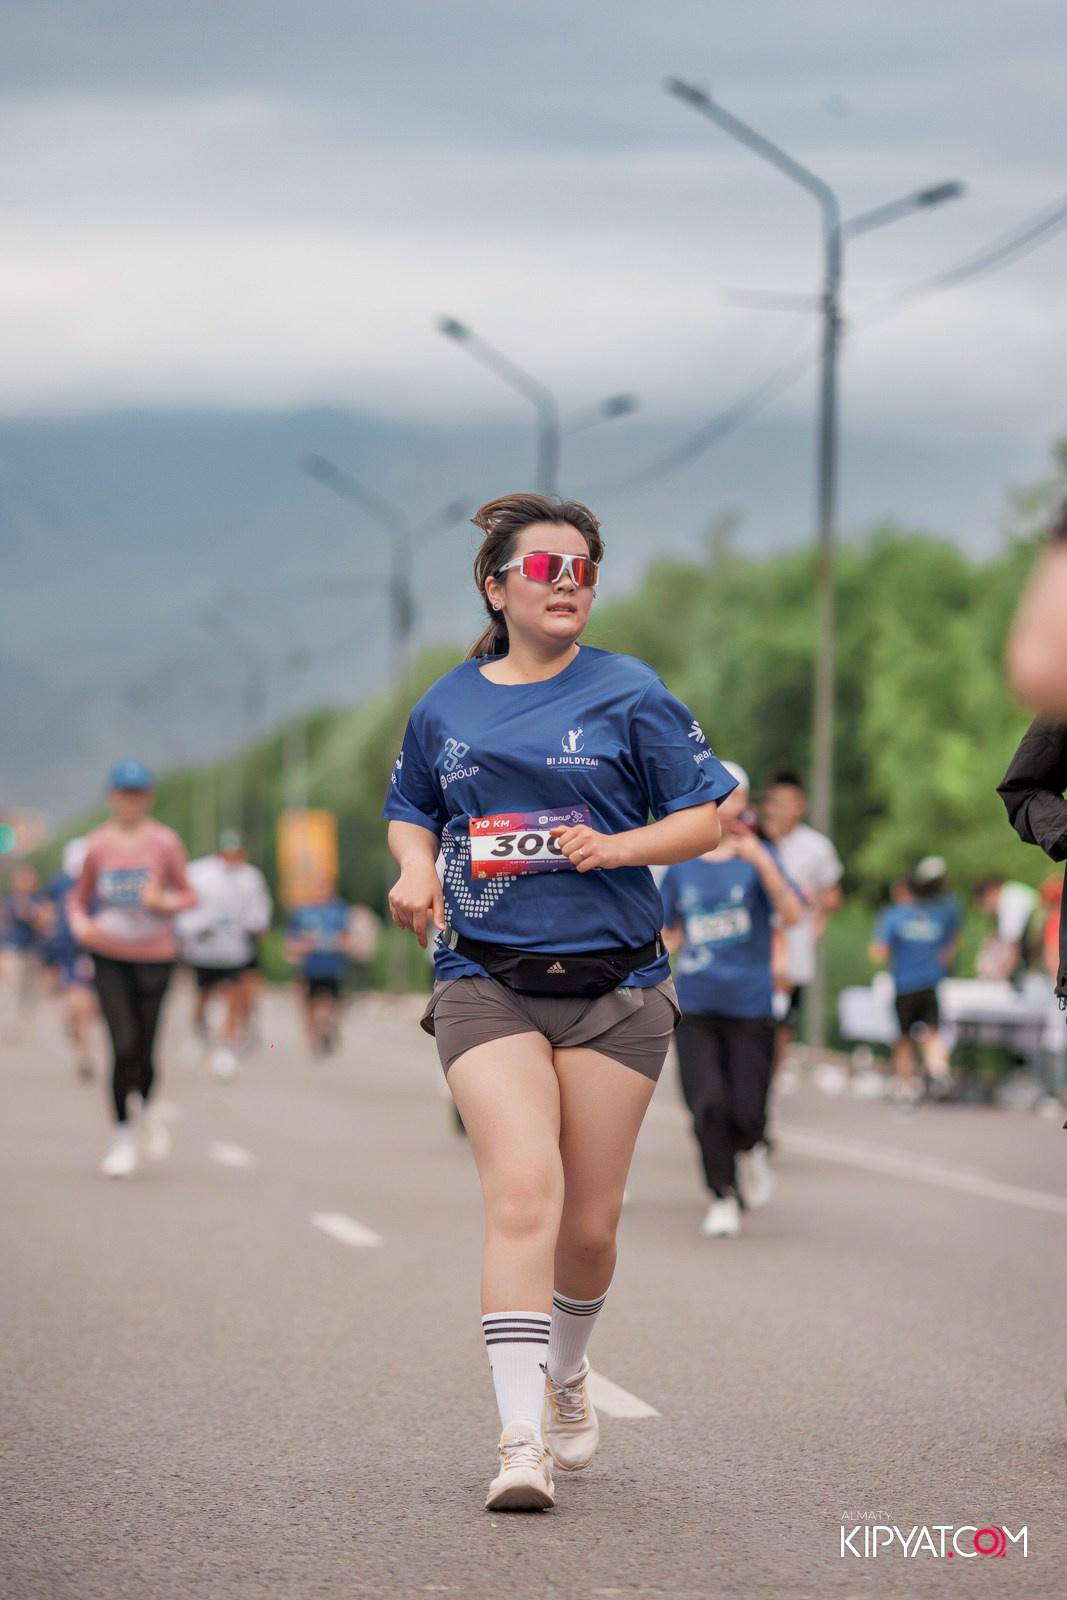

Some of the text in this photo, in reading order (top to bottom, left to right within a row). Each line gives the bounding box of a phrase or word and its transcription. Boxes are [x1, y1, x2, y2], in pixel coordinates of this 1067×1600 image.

[557, 757, 599, 766] JULDYZAI
[446, 766, 480, 783] GROUP
[549, 814, 571, 822] GROUP
[475, 819, 510, 830] 10 KM
